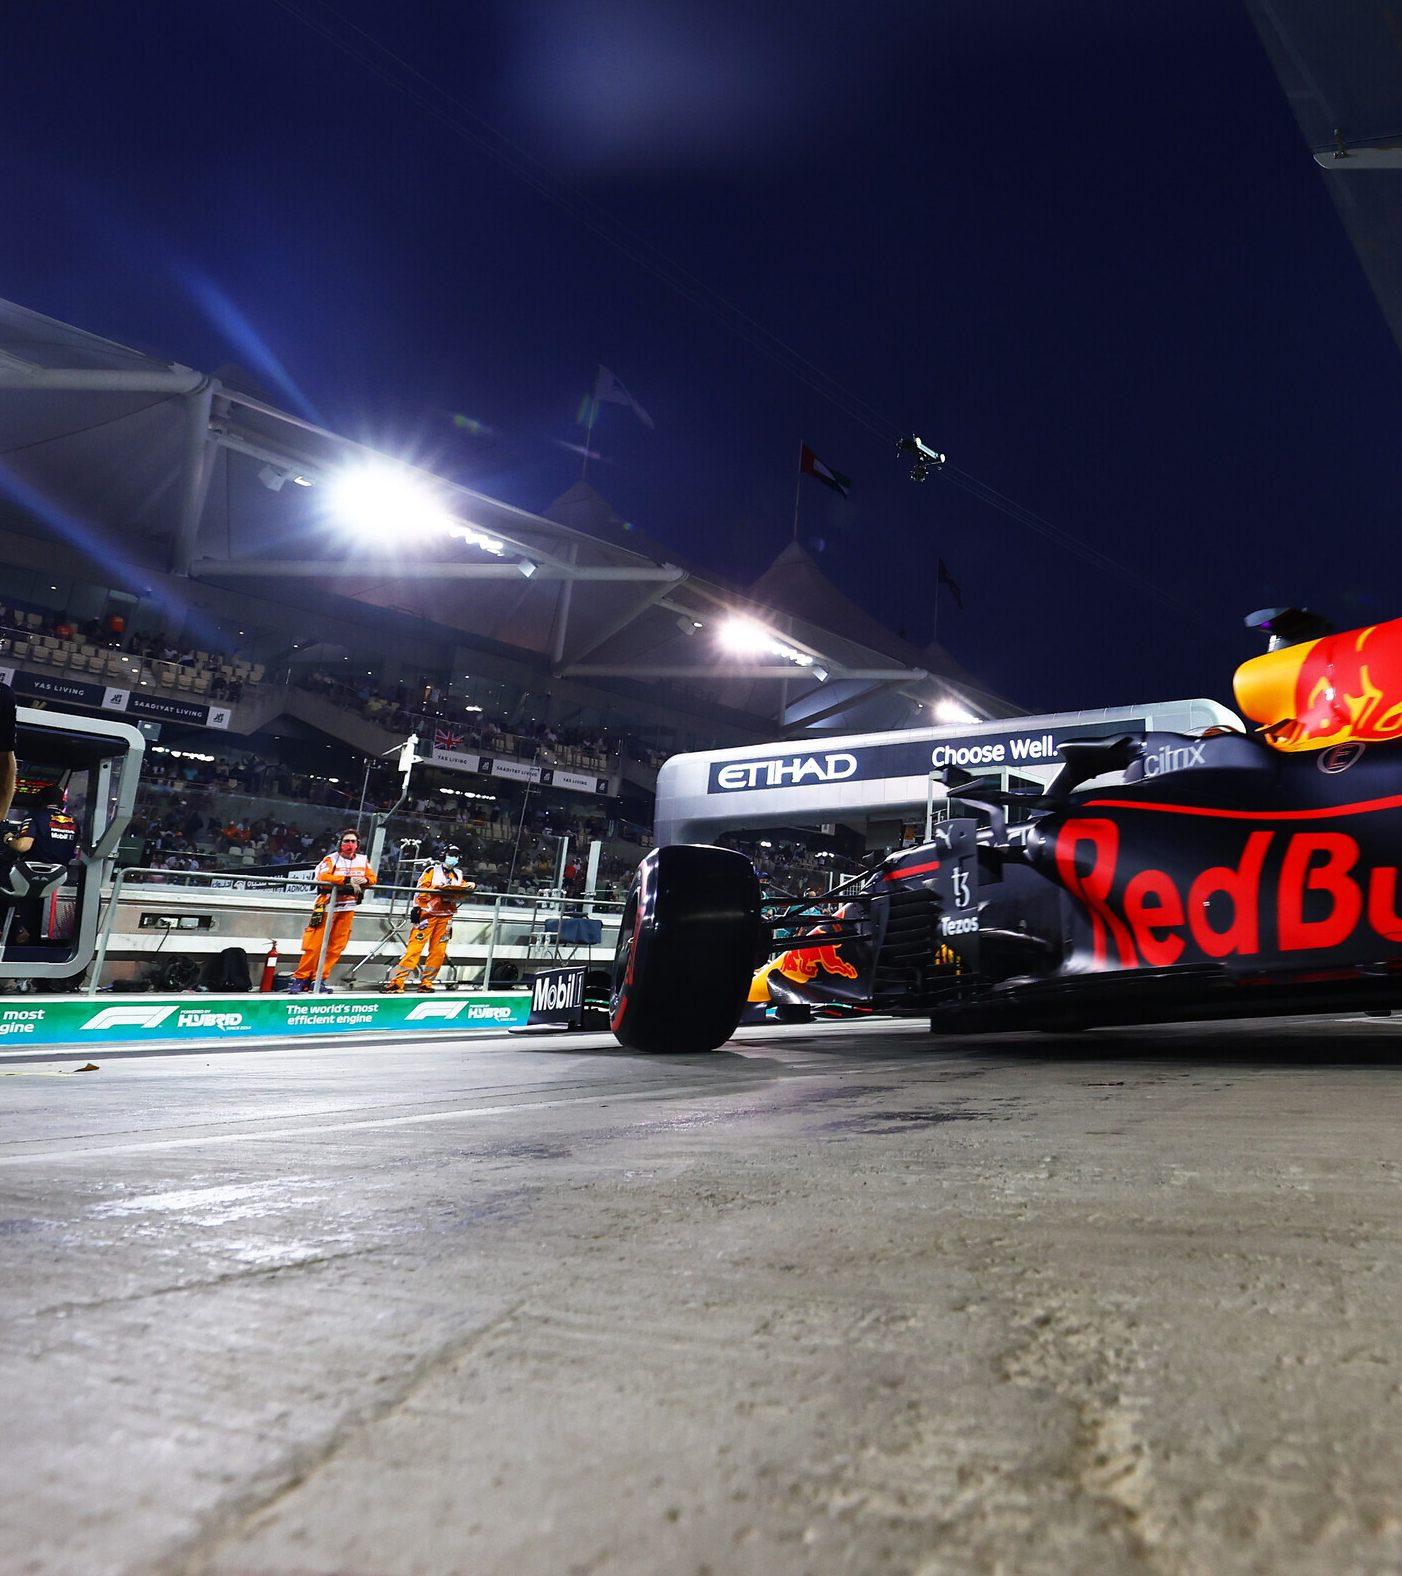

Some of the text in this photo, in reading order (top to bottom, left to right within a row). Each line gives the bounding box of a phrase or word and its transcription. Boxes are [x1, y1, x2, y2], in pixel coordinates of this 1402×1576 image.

[34, 681, 85, 696] YAS LIVING
[134, 700, 203, 718] SAADIYAT LIVING
[931, 735, 1059, 768] Choose Well.
[1143, 738, 1206, 778] citrix
[717, 753, 858, 790] ETIHAD
[941, 916, 979, 936] Tezos
[532, 973, 576, 1011] Mobil
[3, 1009, 46, 1020] most
[286, 1003, 379, 1014] The world's most
[0, 1021, 35, 1035] gine
[177, 1013, 243, 1030] HYBRID
[287, 1014, 373, 1025] efficient engine
